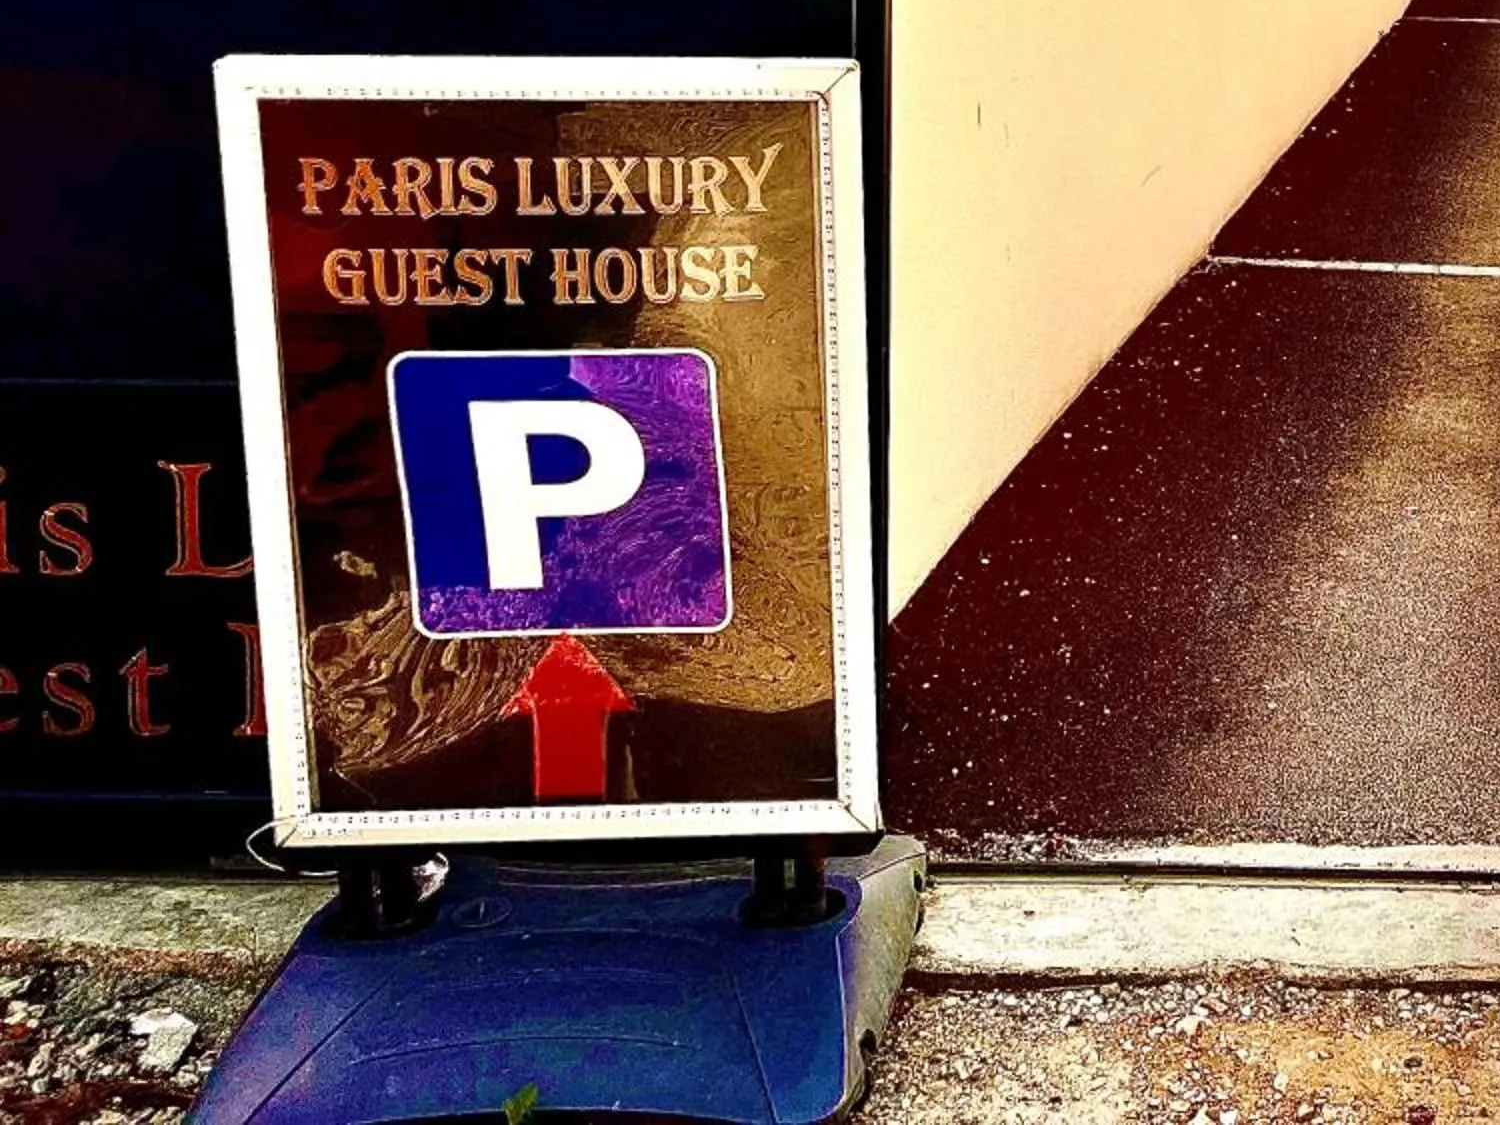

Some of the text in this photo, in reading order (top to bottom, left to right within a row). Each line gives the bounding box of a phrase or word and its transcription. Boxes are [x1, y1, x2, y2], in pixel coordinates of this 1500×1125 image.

[297, 141, 784, 219] PARIS LUXURY
[322, 244, 766, 306] GUEST HOUSE
[467, 400, 646, 590] P
